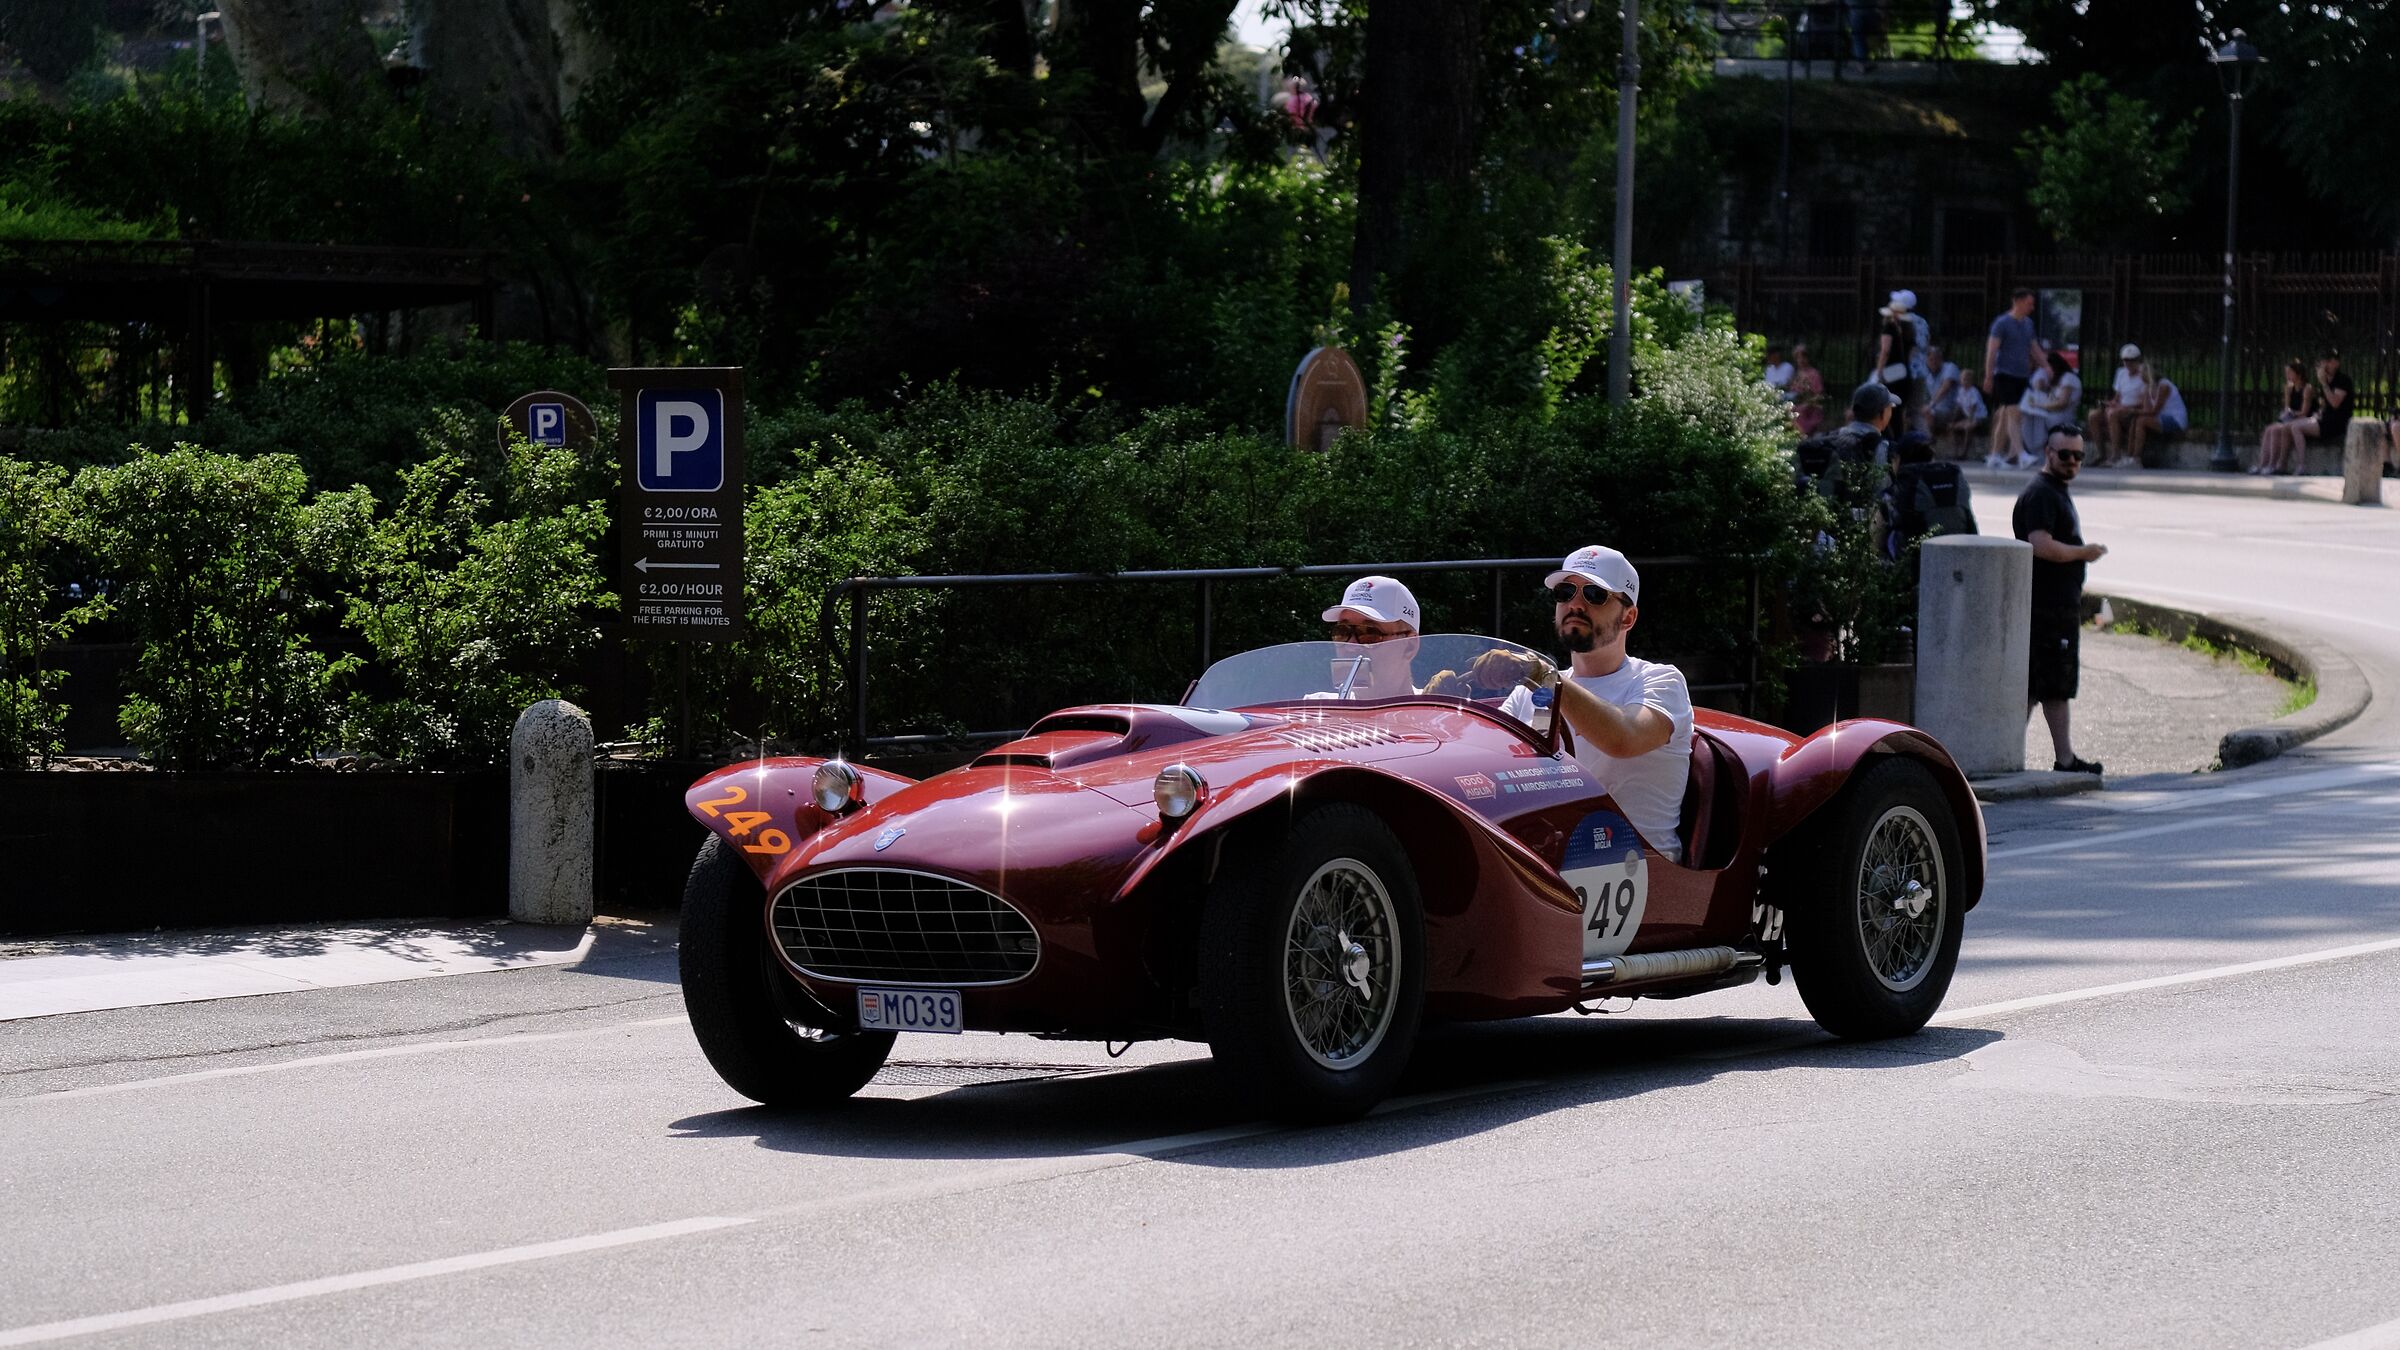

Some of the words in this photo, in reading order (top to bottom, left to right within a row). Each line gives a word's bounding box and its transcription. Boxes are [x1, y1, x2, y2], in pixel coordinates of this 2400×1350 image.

[537, 408, 557, 437] P
[656, 401, 709, 477] P
[644, 507, 652, 518] €
[643, 530, 669, 539] PRIMI
[672, 530, 683, 539] 15
[685, 530, 719, 539] MINUTI
[657, 540, 705, 549] GRATUITO
[639, 583, 647, 594] €
[639, 606, 662, 615] FREE
[664, 606, 702, 615] PARKING
[704, 607, 723, 616] FOR
[632, 616, 650, 624] THE
[652, 616, 678, 625] FIRST
[680, 617, 689, 625] 15
[691, 617, 730, 626] MINUTES
[1459, 777, 1484, 787] 1000
[1465, 786, 1492, 797] MIGLIA
[696, 785, 792, 855] 249
